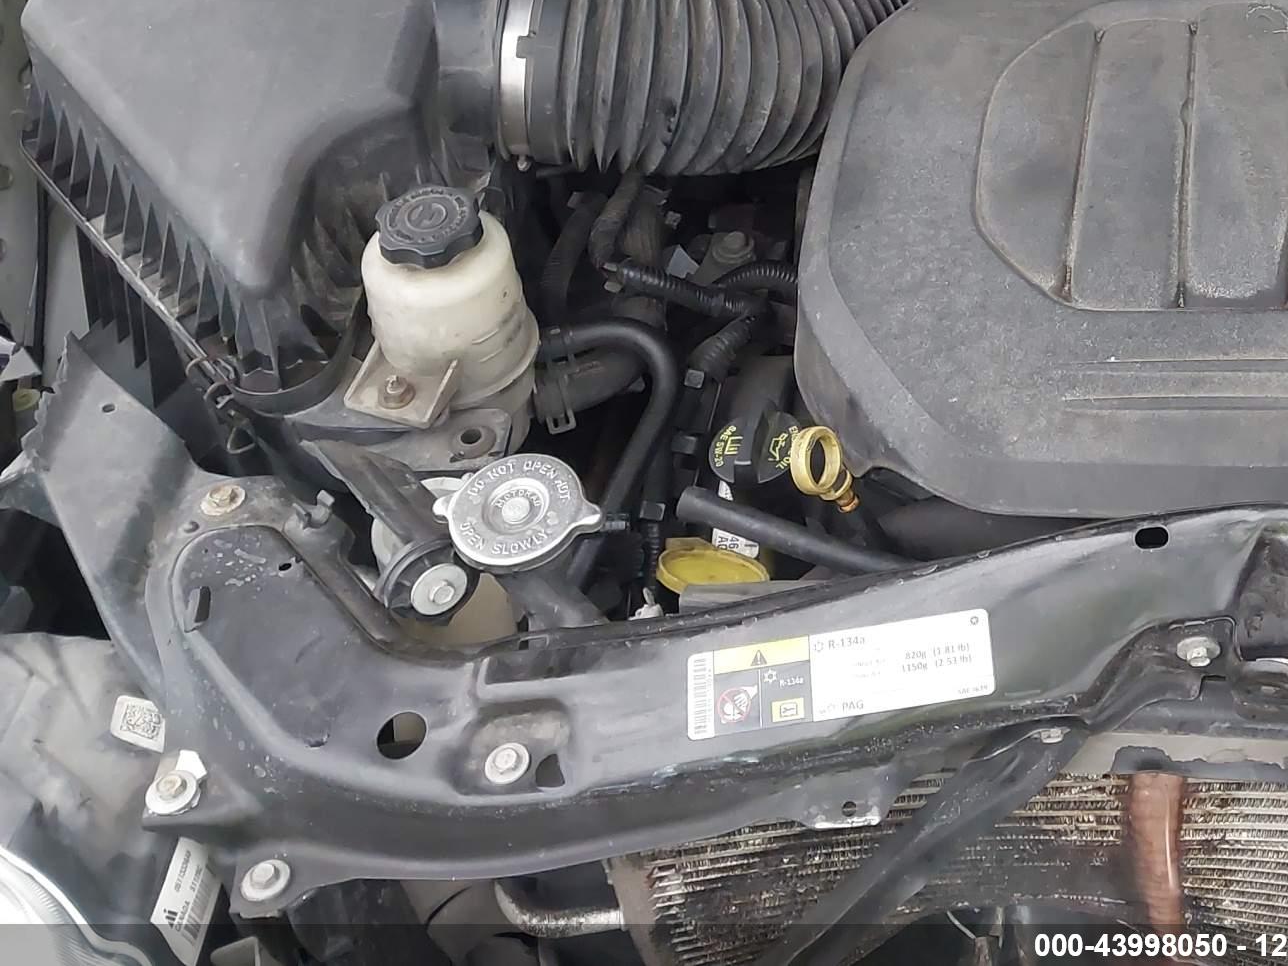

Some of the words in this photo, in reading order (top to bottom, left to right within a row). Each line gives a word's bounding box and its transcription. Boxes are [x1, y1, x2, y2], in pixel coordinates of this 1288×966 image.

[720, 425, 737, 440] SAE
[467, 480, 485, 496] DO
[487, 463, 515, 479] NOT
[523, 460, 557, 479] OPEN
[460, 521, 485, 550] OPEN
[491, 529, 549, 555] SLOWLY
[828, 636, 866, 650] R-134a
[905, 649, 927, 660] 820g
[842, 699, 864, 712] PAG
